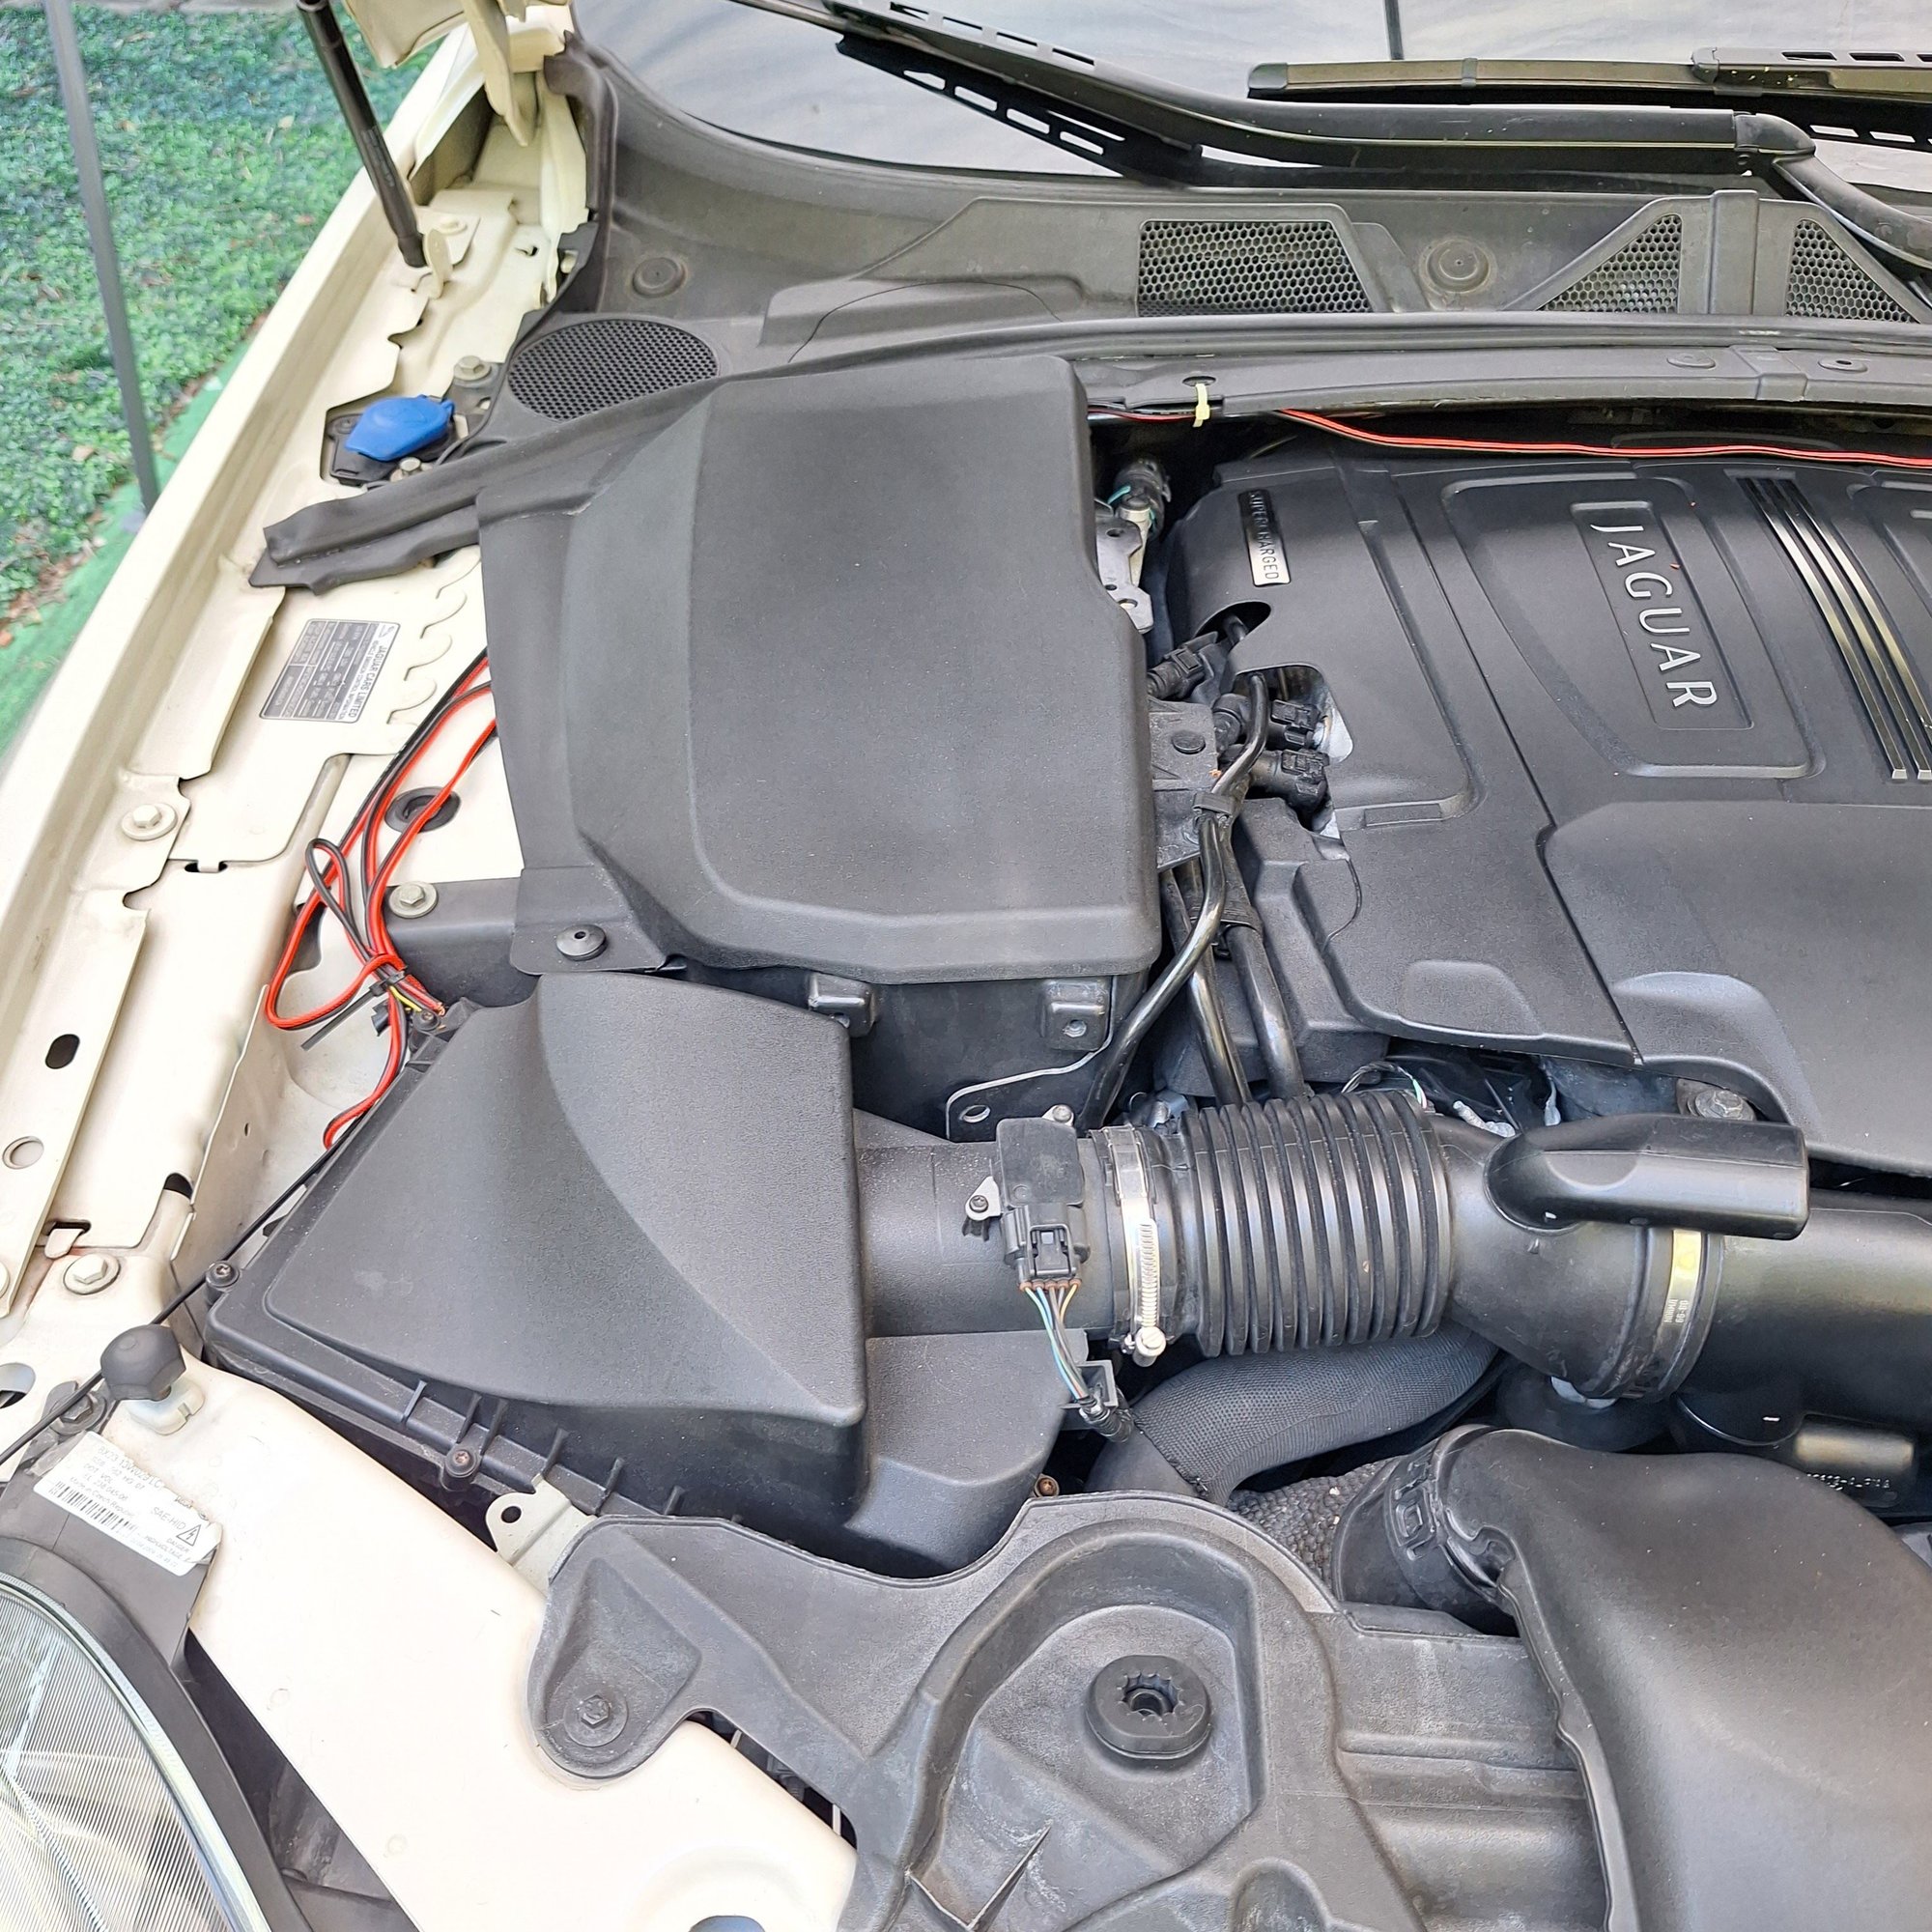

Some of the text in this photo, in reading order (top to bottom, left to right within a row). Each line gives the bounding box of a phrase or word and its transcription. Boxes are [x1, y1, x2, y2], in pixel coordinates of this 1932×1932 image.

[1589, 524, 1719, 708] JAGUAR
[349, 645, 387, 718] JAGUAR CARS LIMITED
